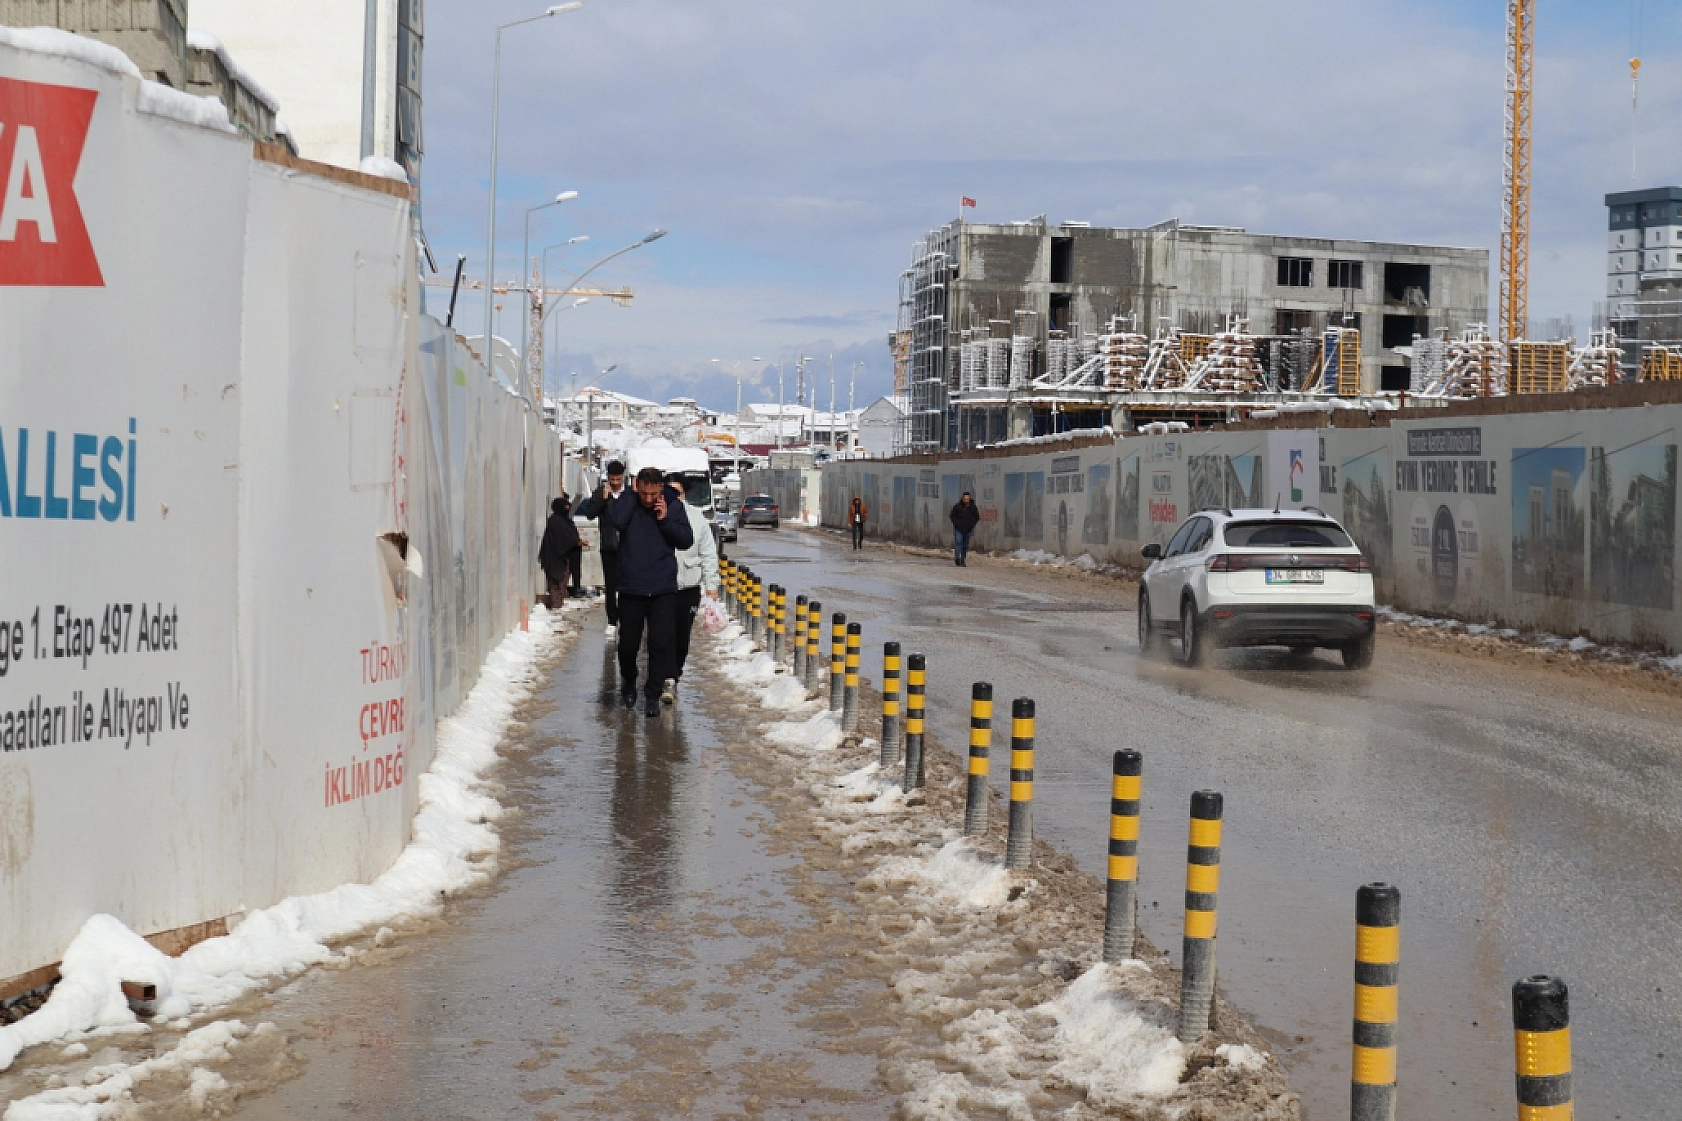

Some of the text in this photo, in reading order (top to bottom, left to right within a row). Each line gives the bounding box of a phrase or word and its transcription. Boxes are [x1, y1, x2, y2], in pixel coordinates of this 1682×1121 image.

[0, 121, 58, 243] A
[31, 605, 46, 659] 1.
[54, 605, 95, 670] Etap
[100, 603, 133, 654] 497
[137, 602, 178, 652] Adet
[0, 681, 189, 752] aatları ile Altyapı Ve
[325, 743, 403, 807] İKLİM DEĞ
